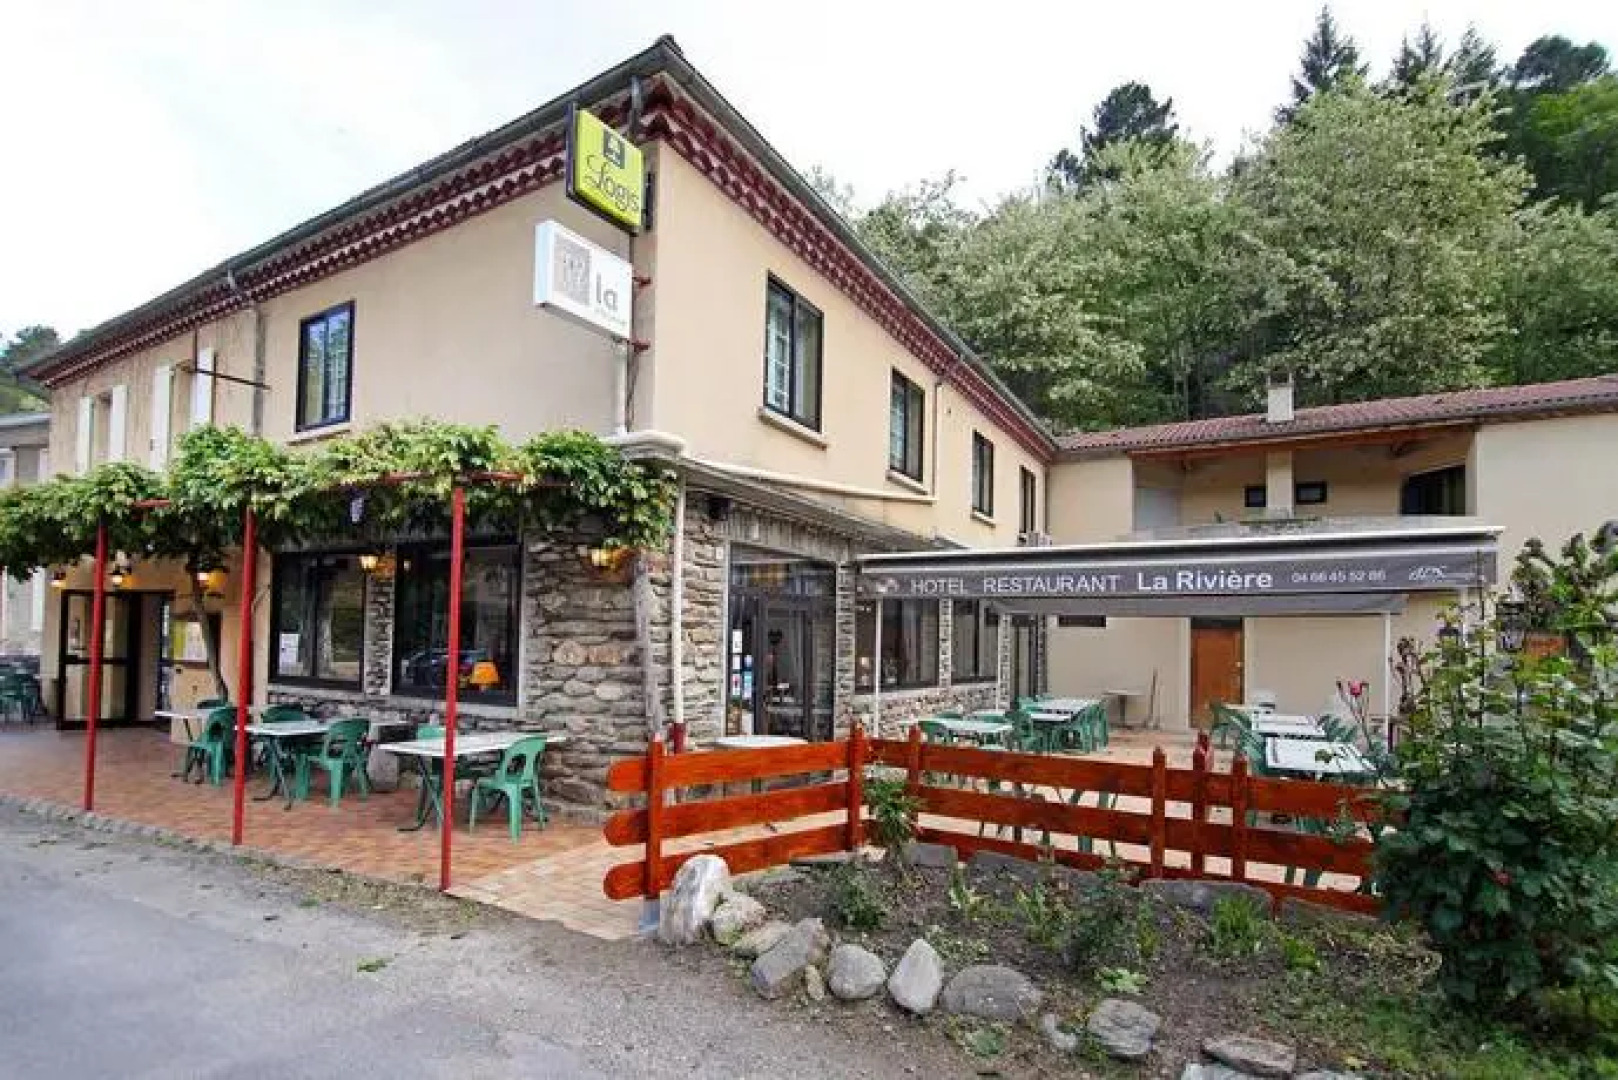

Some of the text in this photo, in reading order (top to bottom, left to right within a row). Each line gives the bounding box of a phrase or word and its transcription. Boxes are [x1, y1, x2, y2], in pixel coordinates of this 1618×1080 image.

[583, 154, 640, 212] Logis
[910, 578, 968, 596] HOTEL
[982, 574, 1121, 594] RESTAURANT
[1137, 571, 1168, 591] La
[1176, 569, 1274, 590] Rivière
